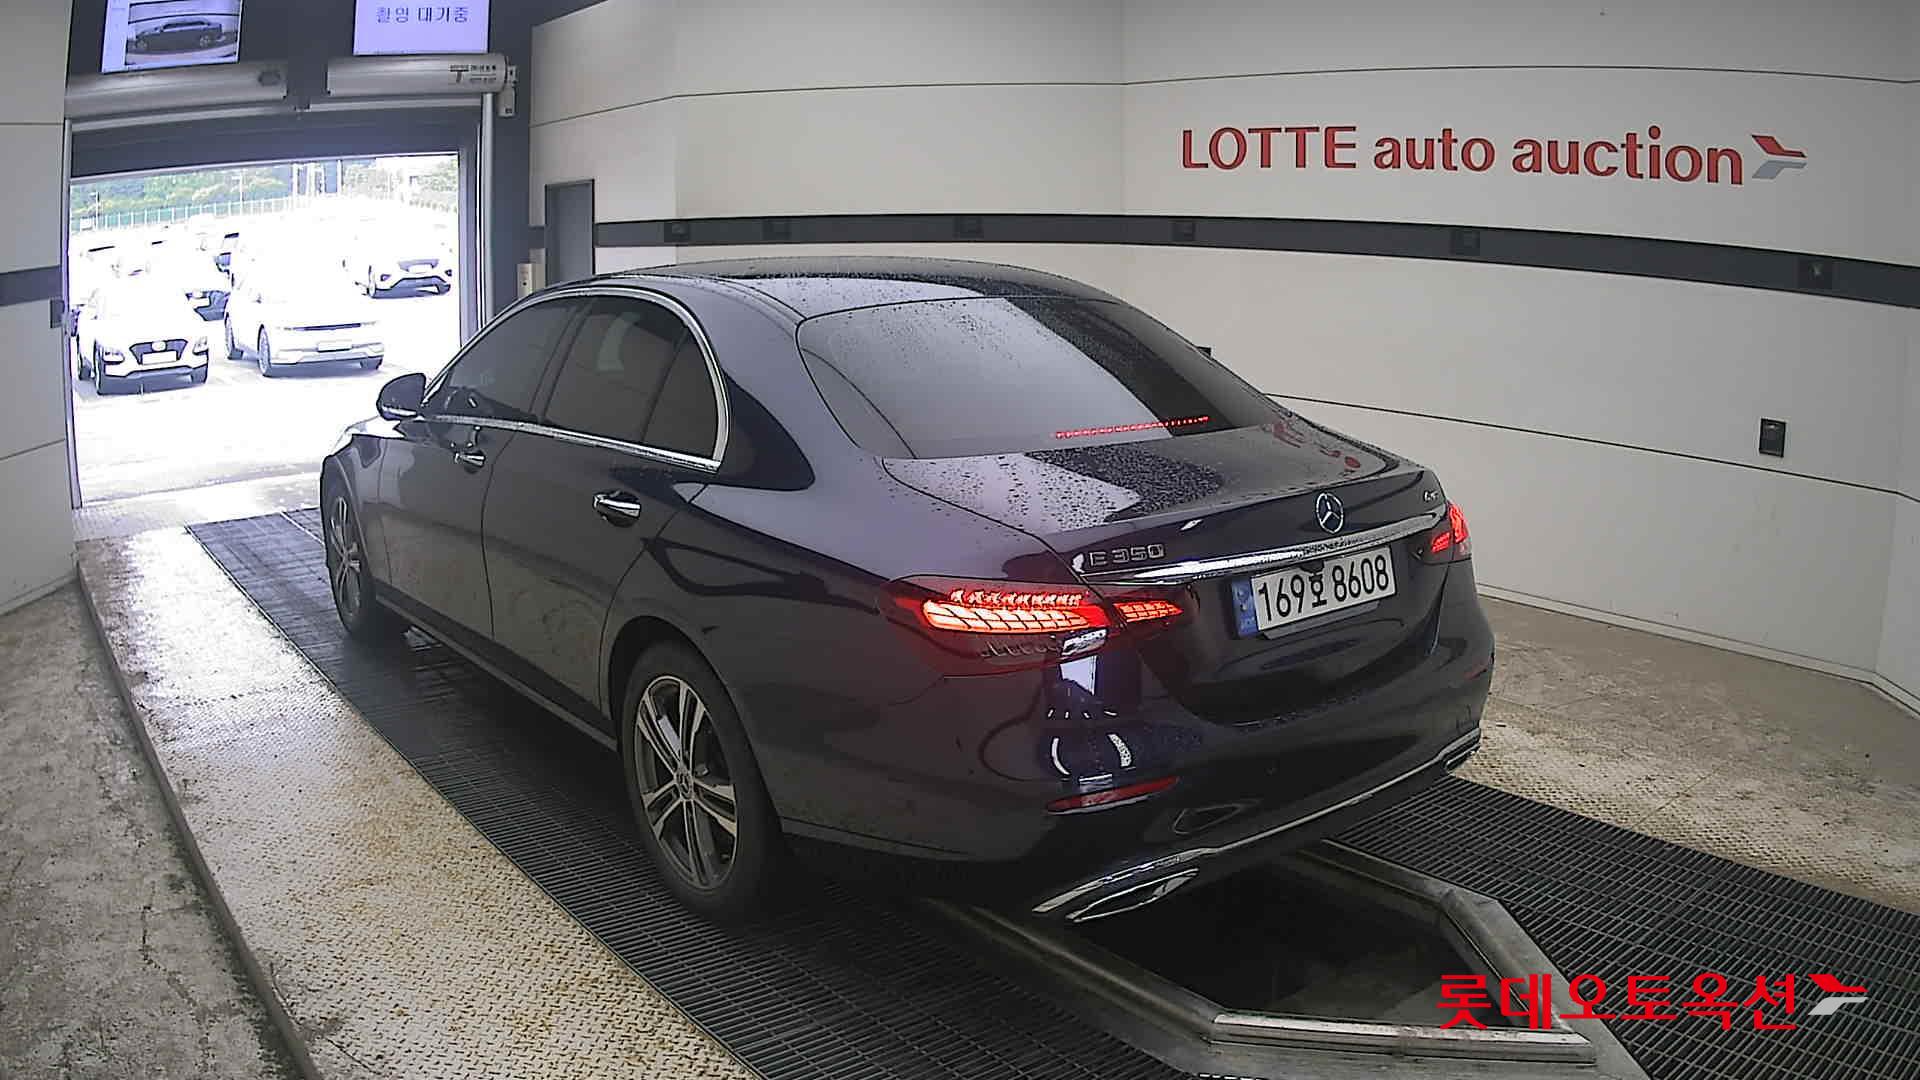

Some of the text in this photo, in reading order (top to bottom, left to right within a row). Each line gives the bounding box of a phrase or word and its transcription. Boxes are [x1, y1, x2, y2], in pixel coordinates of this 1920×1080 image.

[418, 7, 468, 23] 대기중
[1182, 125, 1743, 185] LOTTE auto auction
[1089, 544, 1164, 566] E 350
[1332, 555, 1389, 602] 8608
